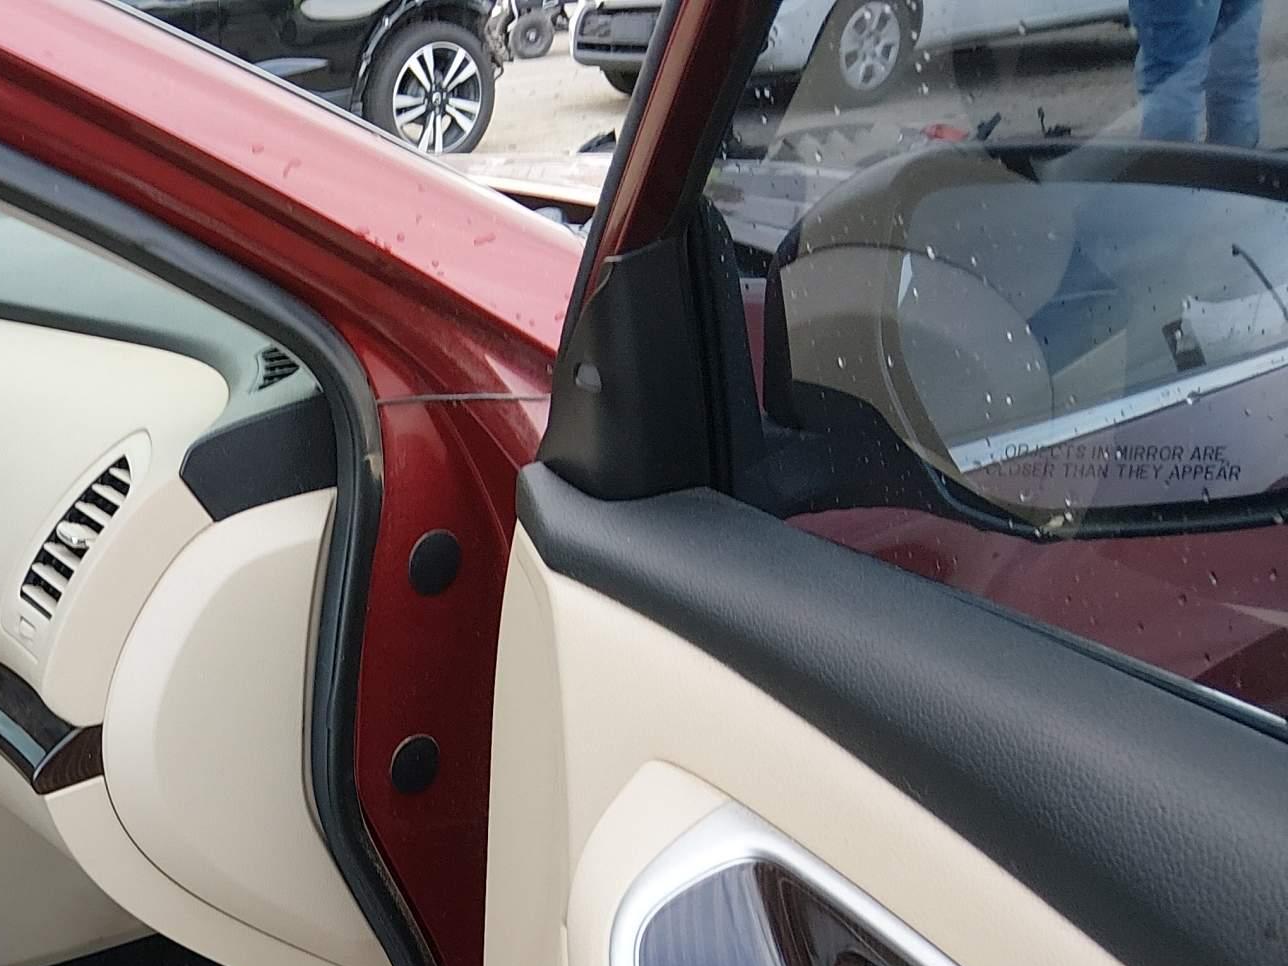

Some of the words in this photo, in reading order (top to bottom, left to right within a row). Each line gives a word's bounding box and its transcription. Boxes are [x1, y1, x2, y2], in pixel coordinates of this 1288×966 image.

[1091, 444, 1110, 461] IN
[1114, 445, 1184, 461] MIRROR
[1190, 445, 1227, 461] ARE
[1063, 463, 1109, 479] THAN
[1117, 464, 1163, 480] THEY
[1168, 464, 1242, 481] APPEAR
